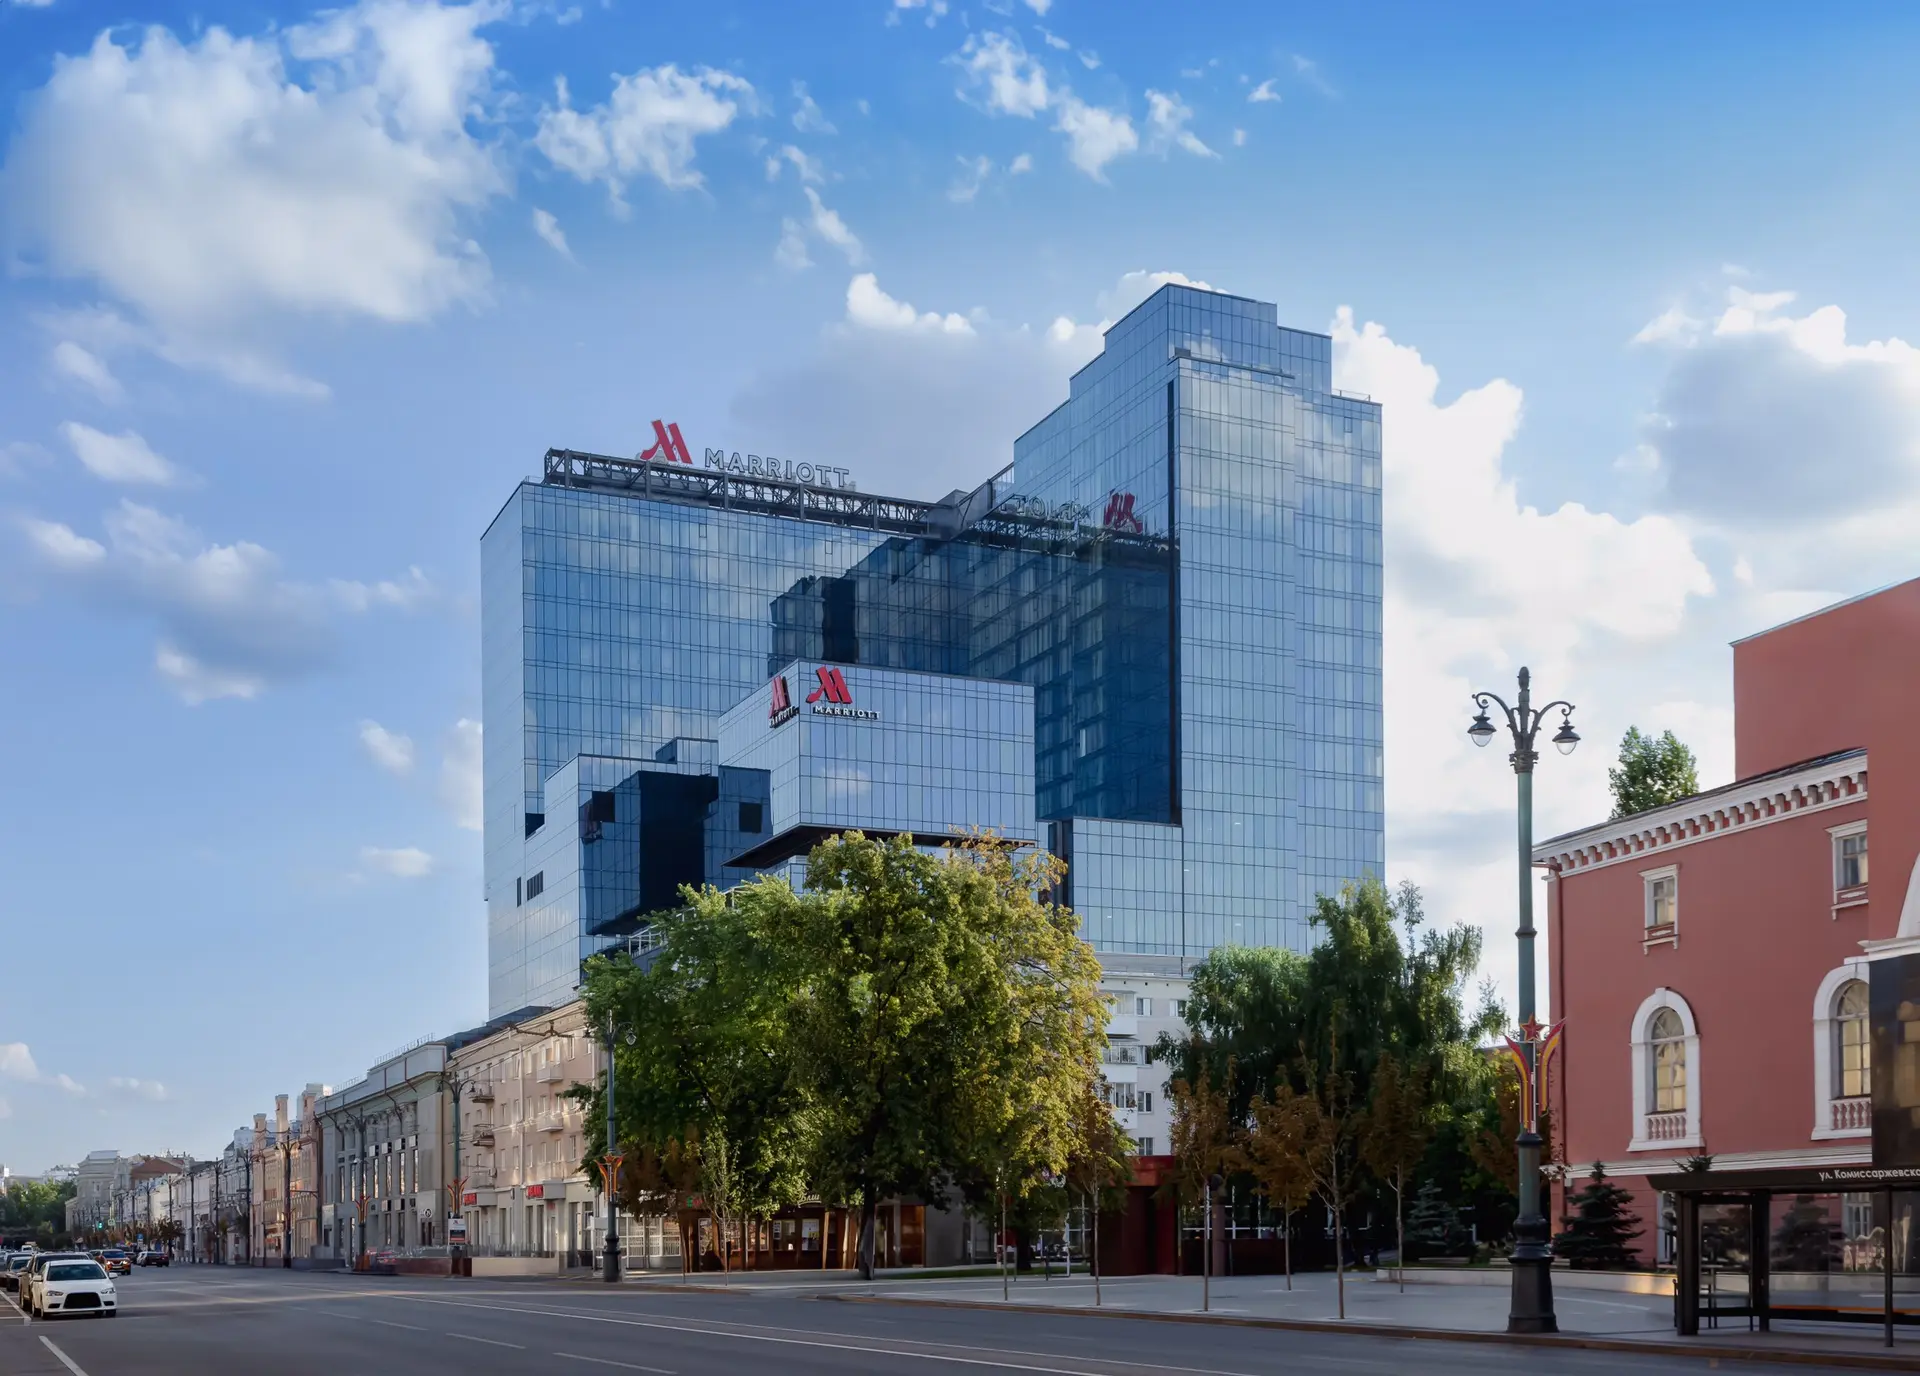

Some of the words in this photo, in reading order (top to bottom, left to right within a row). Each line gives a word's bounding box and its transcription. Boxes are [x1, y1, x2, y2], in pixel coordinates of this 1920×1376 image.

[704, 447, 850, 488] MARRIOTT
[814, 705, 881, 719] MARRIOTT
[1818, 1171, 1833, 1182] ул.
